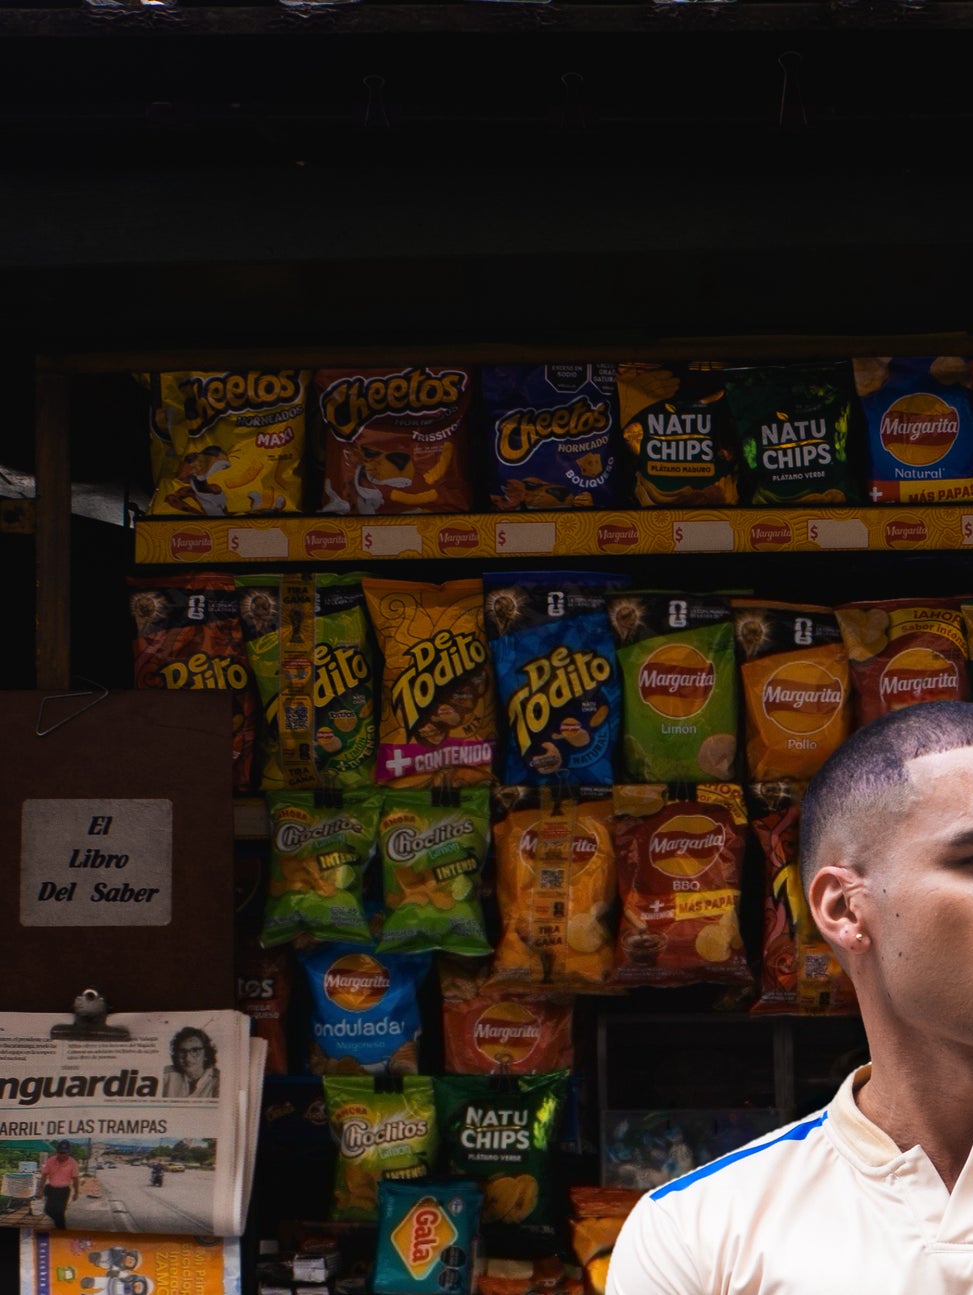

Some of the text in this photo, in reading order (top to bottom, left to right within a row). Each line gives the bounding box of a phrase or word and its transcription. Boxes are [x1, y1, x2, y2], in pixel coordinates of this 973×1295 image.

[325, 368, 460, 440] Cheetos
[236, 405, 304, 427] HORNEADOS
[647, 413, 711, 436] NATU
[257, 427, 294, 447] MAXI
[500, 401, 608, 460] Cheetos
[761, 418, 827, 446] NATU
[881, 416, 958, 441] Margarita
[646, 440, 714, 462] CHIPS
[762, 444, 832, 470] CHIPS
[894, 467, 943, 479] Natural
[908, 487, 935, 502] MÁS
[170, 534, 213, 549] Margarita
[305, 532, 348, 548] Margarita
[438, 529, 480, 545] Margarita
[599, 528, 639, 543] Margarita
[751, 526, 792, 543] Margarita
[886, 523, 928, 539] Margarita
[411, 630, 452, 668] De
[525, 647, 571, 694] De
[393, 634, 486, 730] Todito
[640, 671, 715, 693] Margarita
[881, 674, 959, 696] Margarita
[507, 651, 612, 757] Todito
[763, 685, 841, 708] Margarita
[661, 721, 697, 735] Limón
[788, 739, 817, 751] Pollo
[414, 743, 492, 770] CONTENIDO
[88, 816, 112, 835] El
[388, 820, 474, 862] Choclitos
[651, 834, 725, 854] Margarita
[69, 849, 129, 869] Libro
[38, 882, 159, 902] Del Saber
[673, 881, 700, 891] BBQ
[325, 974, 391, 992] Margarita
[475, 1023, 540, 1042] Margarita
[47, 1119, 167, 1135] DE LAS TRAMPAS
[467, 1106, 528, 1128] NATU
[341, 1120, 427, 1157] Choclitos
[461, 1129, 530, 1150] CHIPS
[411, 1209, 438, 1264] Gala
